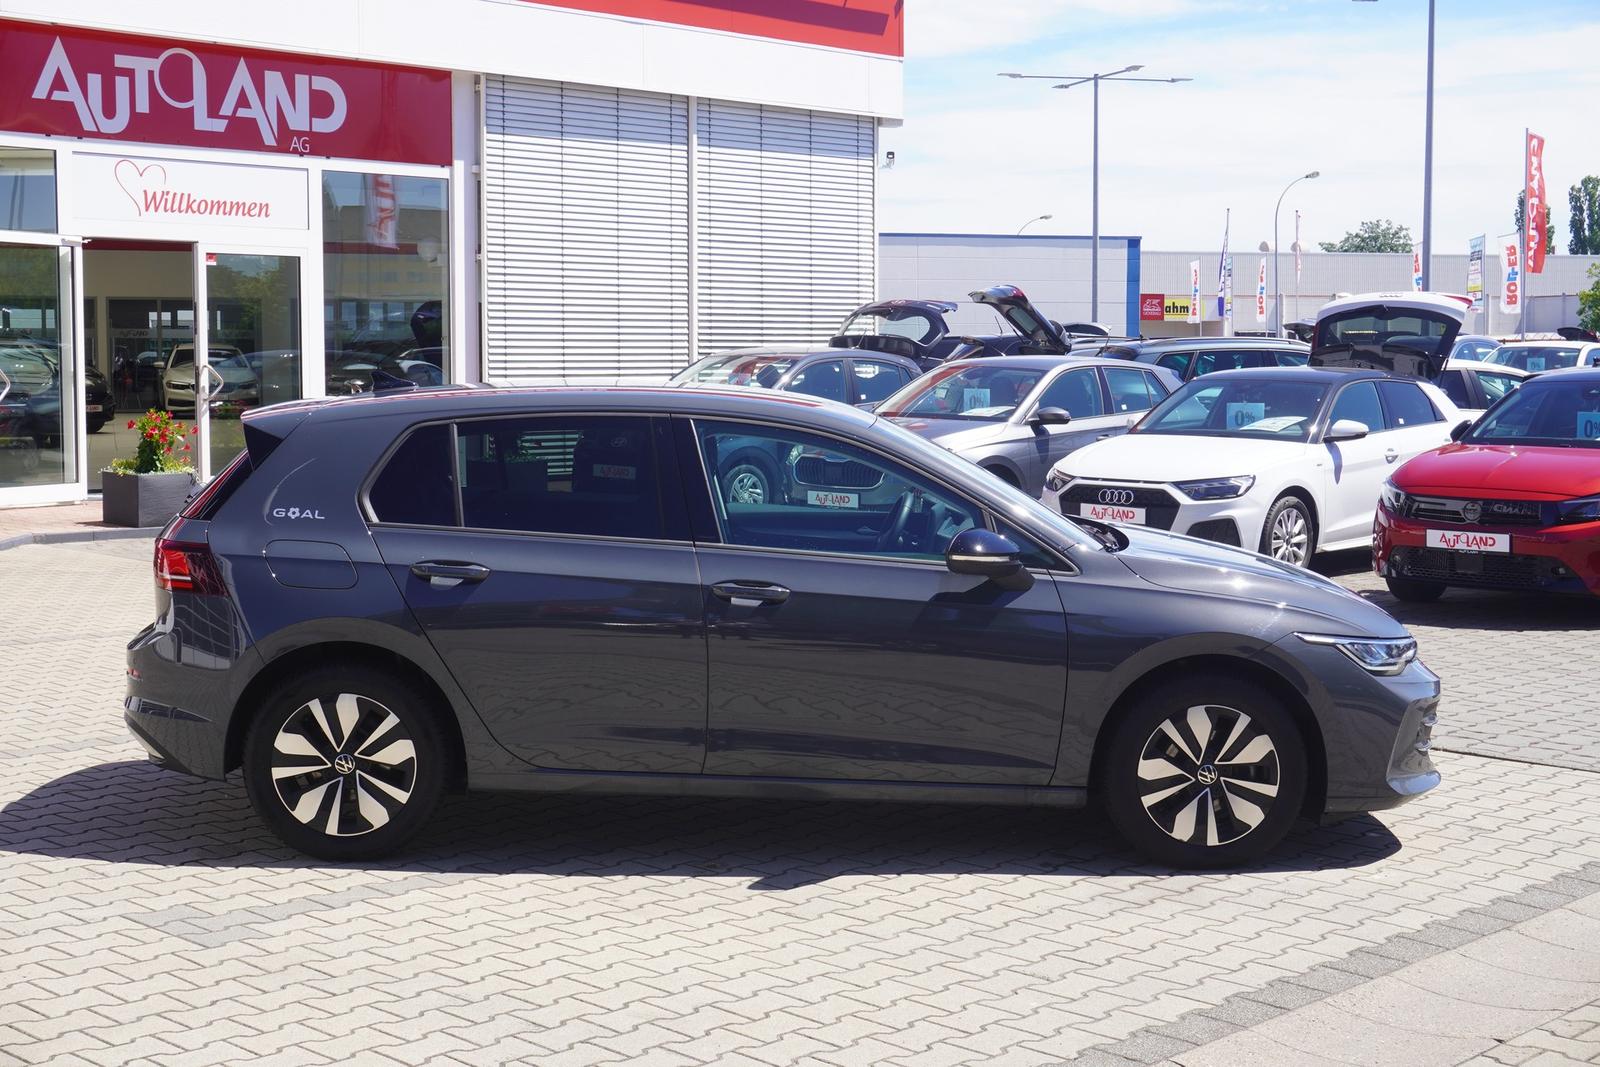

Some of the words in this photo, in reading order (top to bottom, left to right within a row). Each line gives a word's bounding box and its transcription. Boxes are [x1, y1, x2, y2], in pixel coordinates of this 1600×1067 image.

[31, 35, 348, 147] AUTOLAND
[290, 136, 310, 153] AG
[143, 189, 271, 218] Willkommen
[1234, 410, 1255, 426] 0%
[272, 507, 325, 519] GOAL
[1091, 506, 1136, 522] AUTOLAND
[1439, 532, 1496, 550] AUTOLAND
